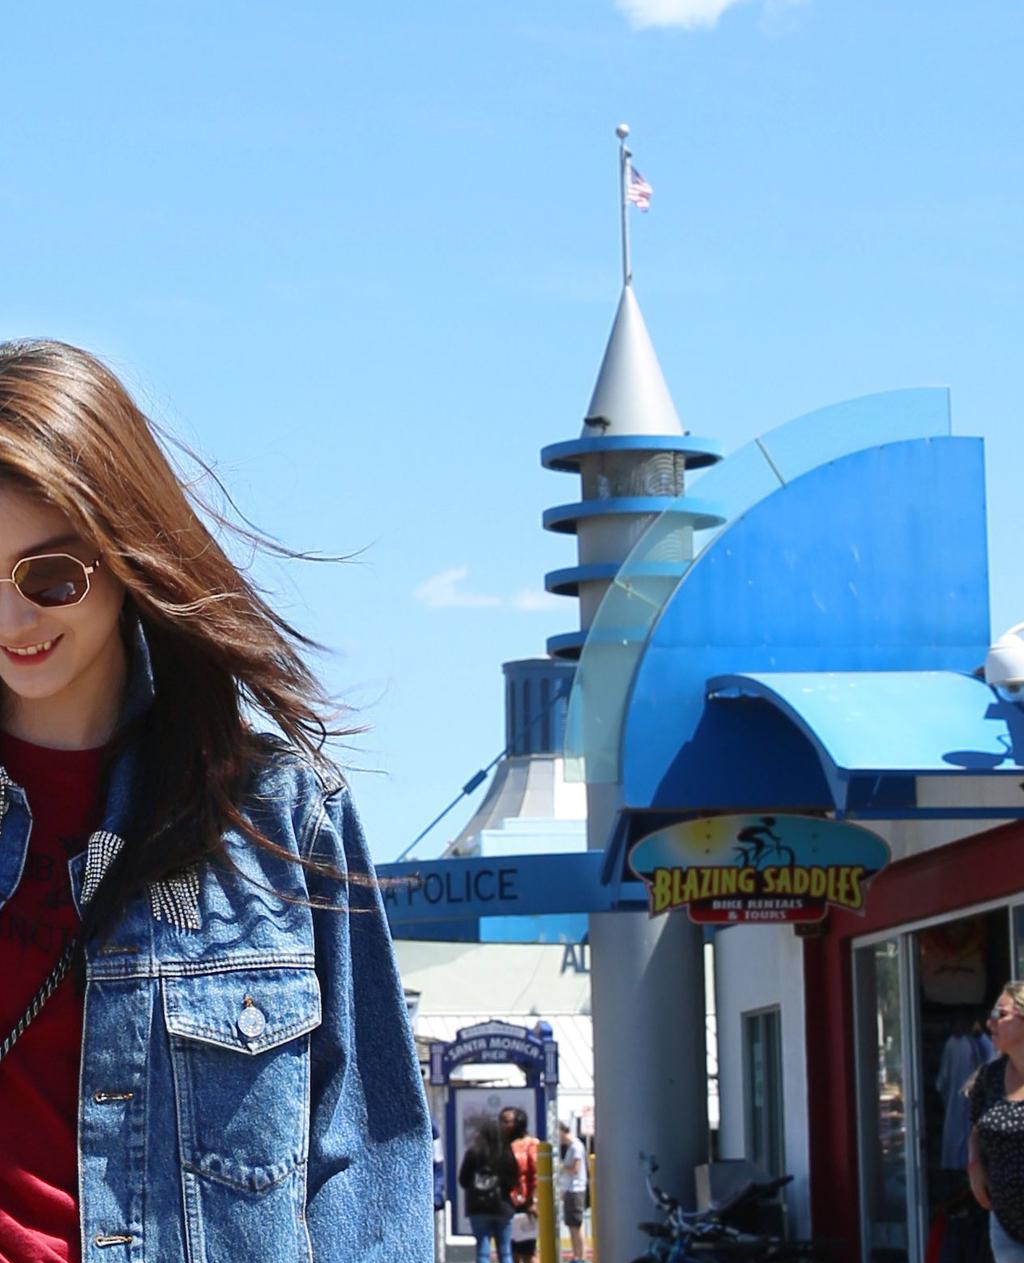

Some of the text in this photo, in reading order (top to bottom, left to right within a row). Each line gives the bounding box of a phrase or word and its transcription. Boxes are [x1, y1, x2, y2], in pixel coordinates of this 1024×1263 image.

[407, 868, 519, 906] POLICE
[652, 867, 864, 912] BLAZING SADDLES
[712, 899, 803, 909] BIKE RENTALS
[727, 911, 787, 920] & TOURS
[448, 1037, 540, 1060] SANTA MONICA
[481, 1050, 507, 1060] PIER
